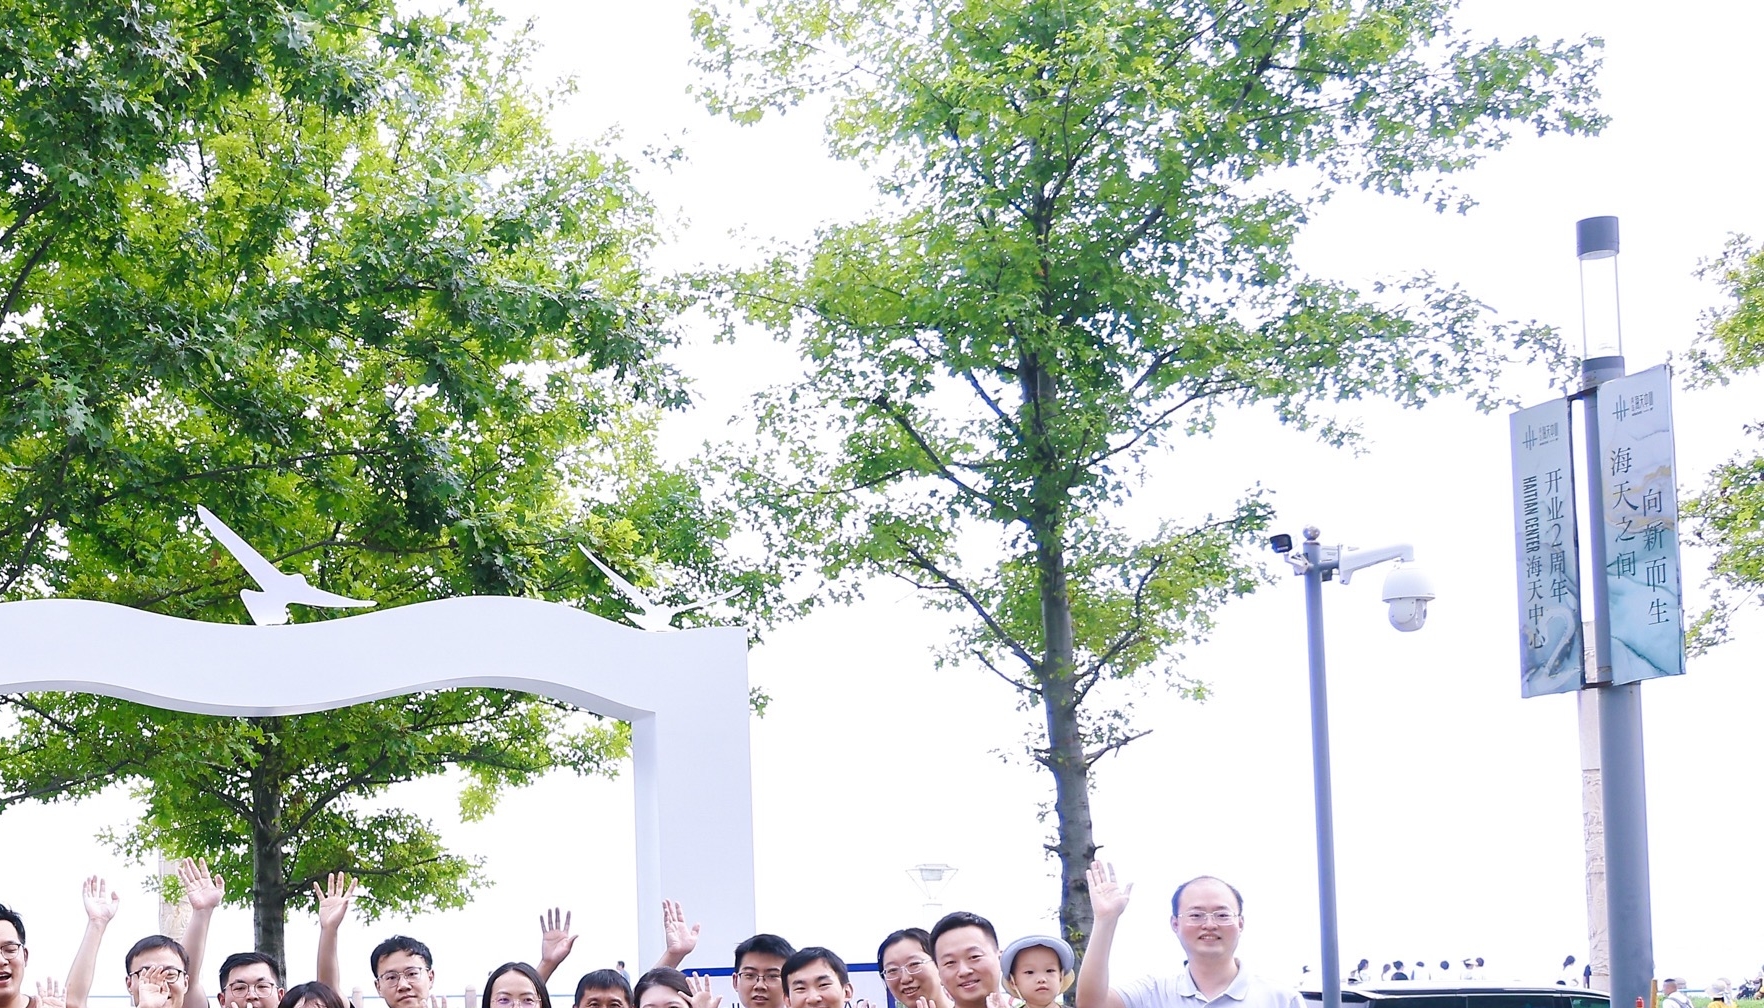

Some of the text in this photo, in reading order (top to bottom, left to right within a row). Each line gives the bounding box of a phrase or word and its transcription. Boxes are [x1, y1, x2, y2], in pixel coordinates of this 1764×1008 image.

[1523, 475, 1541, 554] HAITIAN CENTER
[1544, 468, 1568, 604] 开业2周年
[1611, 447, 1639, 580] 海天之间
[1642, 488, 1670, 627] 向新而生
[1525, 555, 1546, 650] 海天中心
